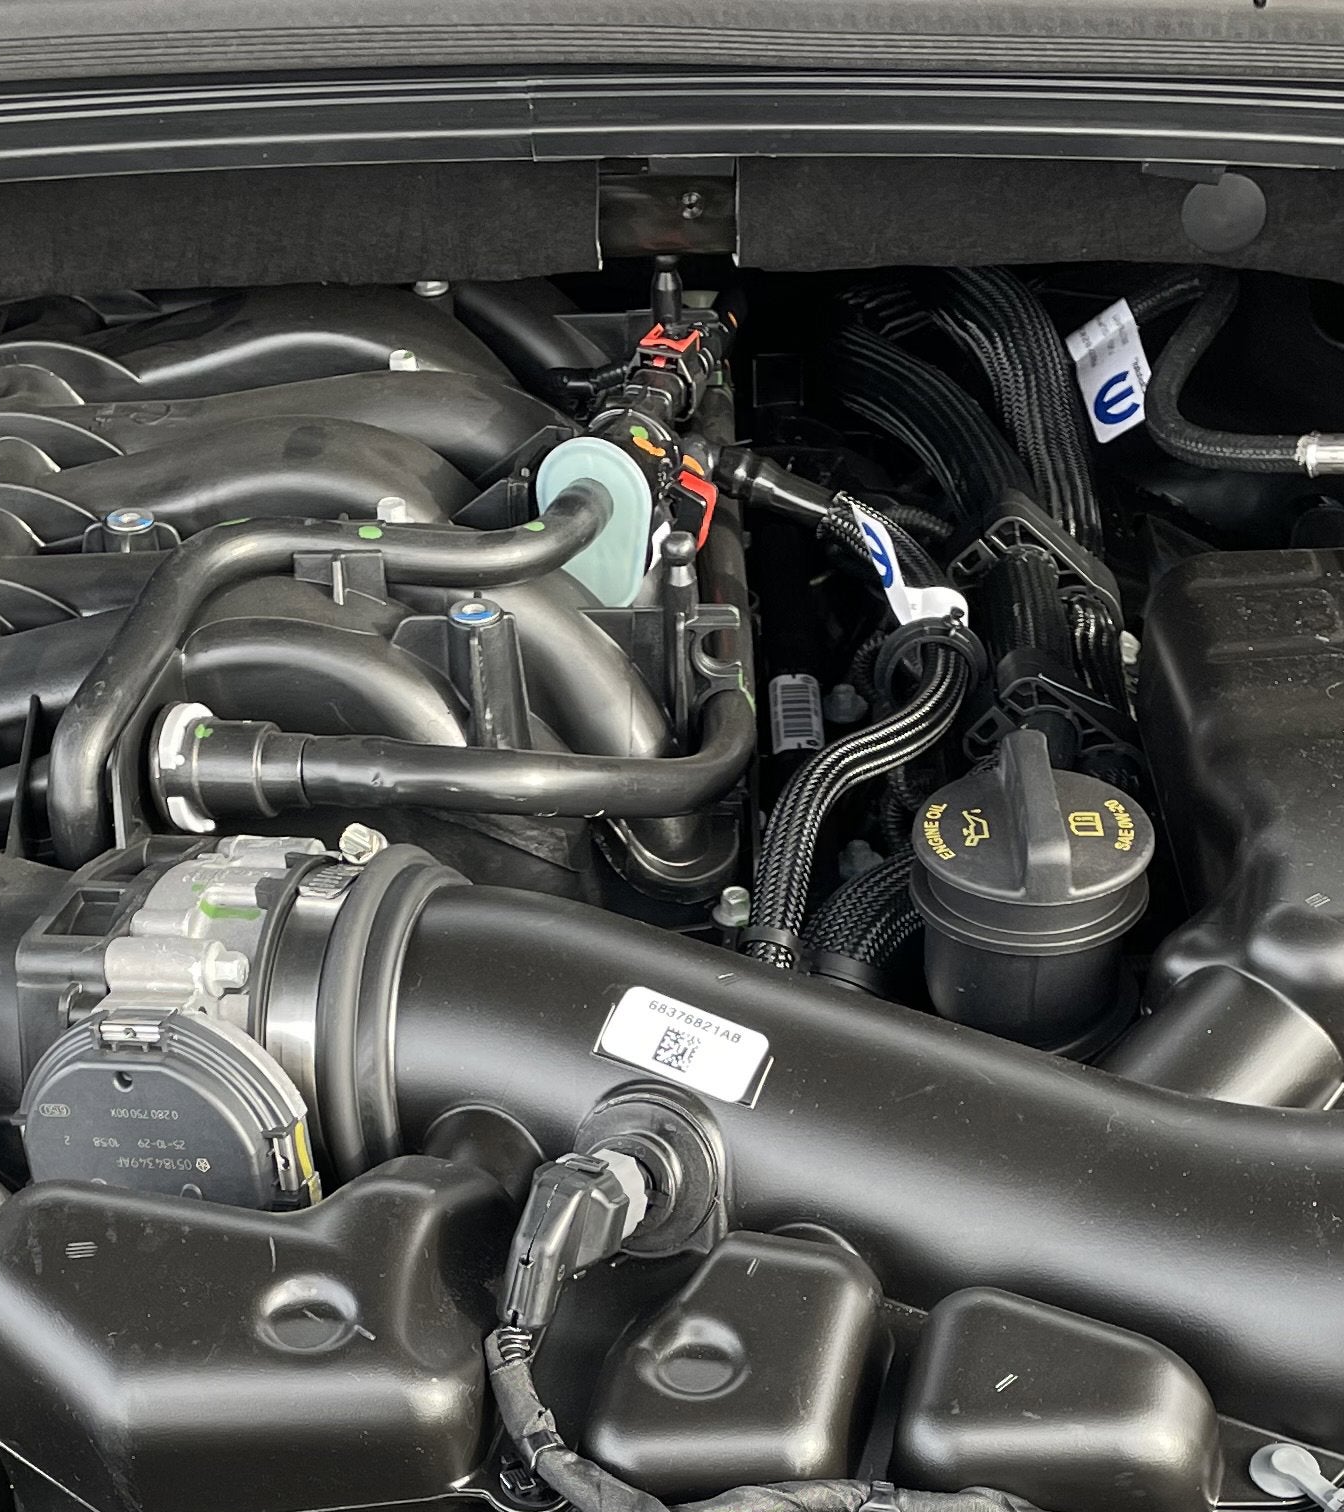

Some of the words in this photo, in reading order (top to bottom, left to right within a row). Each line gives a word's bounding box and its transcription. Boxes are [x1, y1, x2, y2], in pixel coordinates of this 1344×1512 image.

[931, 802, 948, 820] OIL
[1104, 799, 1134, 829] 0W-20
[924, 820, 956, 860] ENGINE
[1114, 829, 1134, 851] SAE
[648, 1000, 742, 1043] 68376821AB
[116, 1157, 192, 1171] 05184349AF
